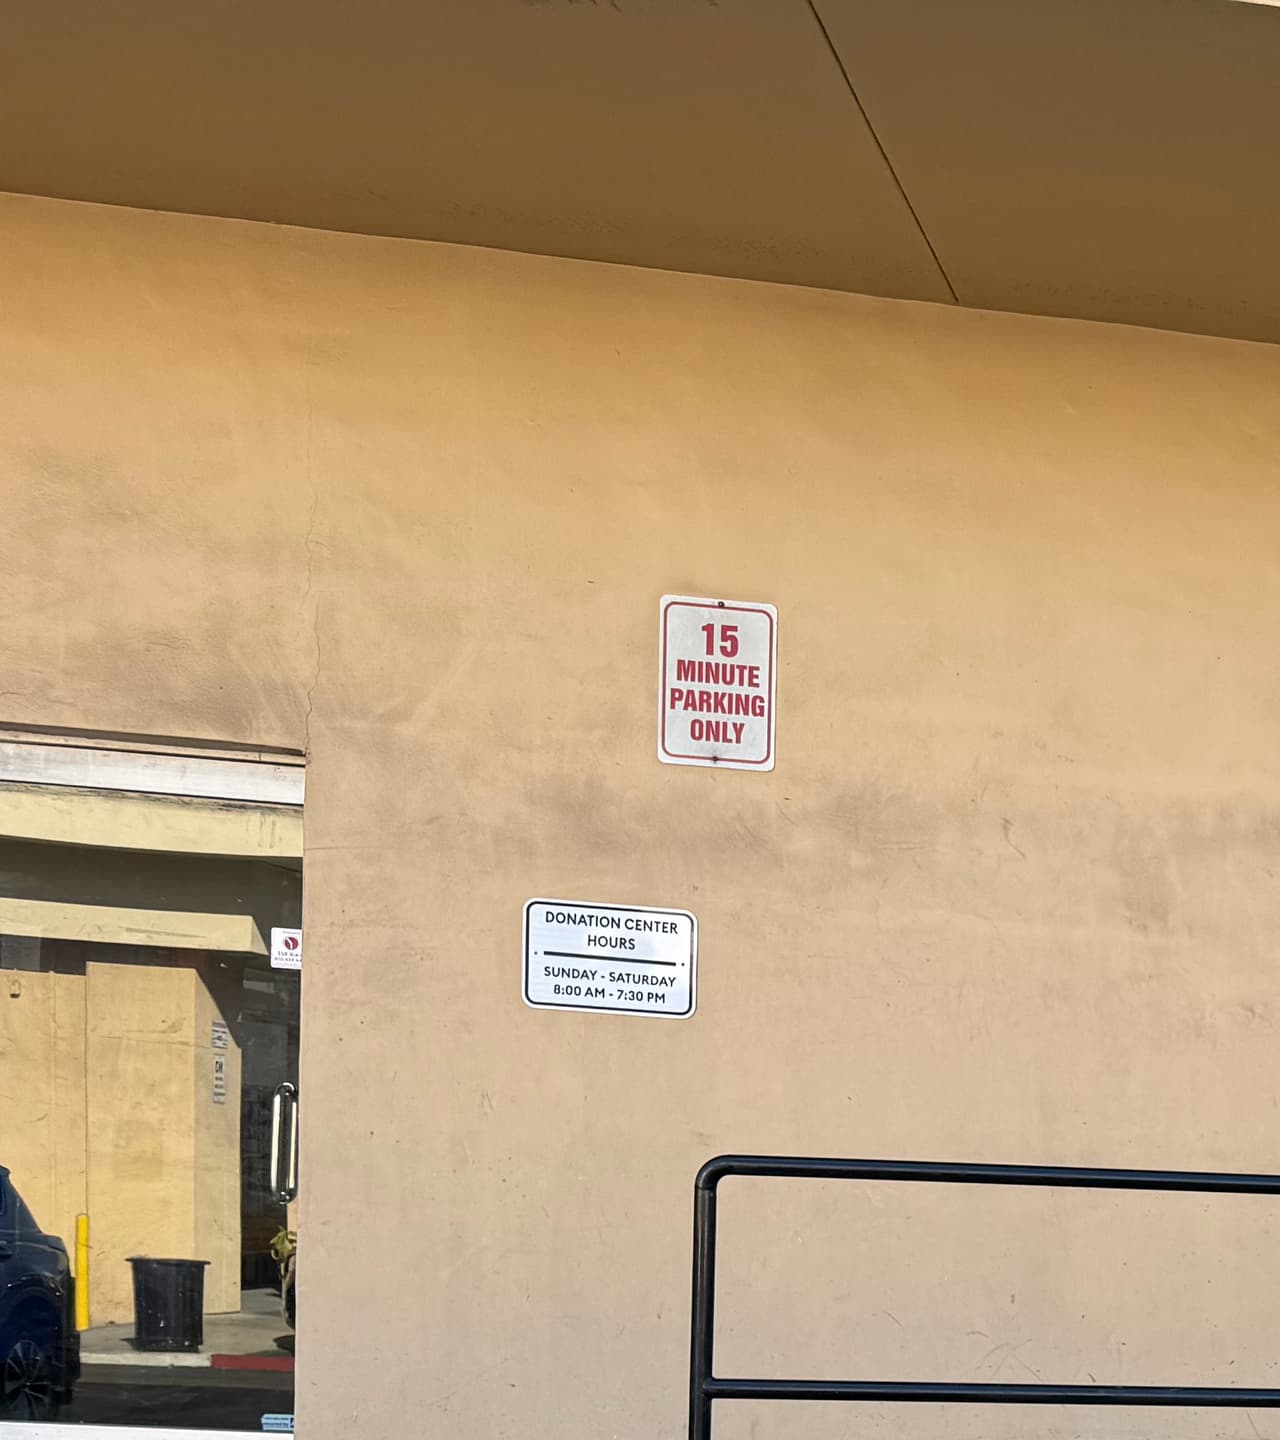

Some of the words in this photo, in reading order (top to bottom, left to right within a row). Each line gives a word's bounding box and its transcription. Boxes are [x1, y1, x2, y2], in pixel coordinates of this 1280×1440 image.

[701, 623, 739, 658] 15
[676, 659, 760, 688] MINUTE
[670, 687, 765, 717] PARKING
[690, 718, 745, 744] ONLY
[545, 911, 621, 929] DONATION
[624, 919, 679, 934] CENTER
[587, 934, 636, 950] HOURS
[544, 966, 598, 981] SUNDAY
[608, 972, 677, 988] SATURDAY
[553, 984, 581, 997] 8:00
[584, 987, 606, 999] AM
[616, 989, 644, 1002] 7:30
[647, 992, 666, 1004] PM
